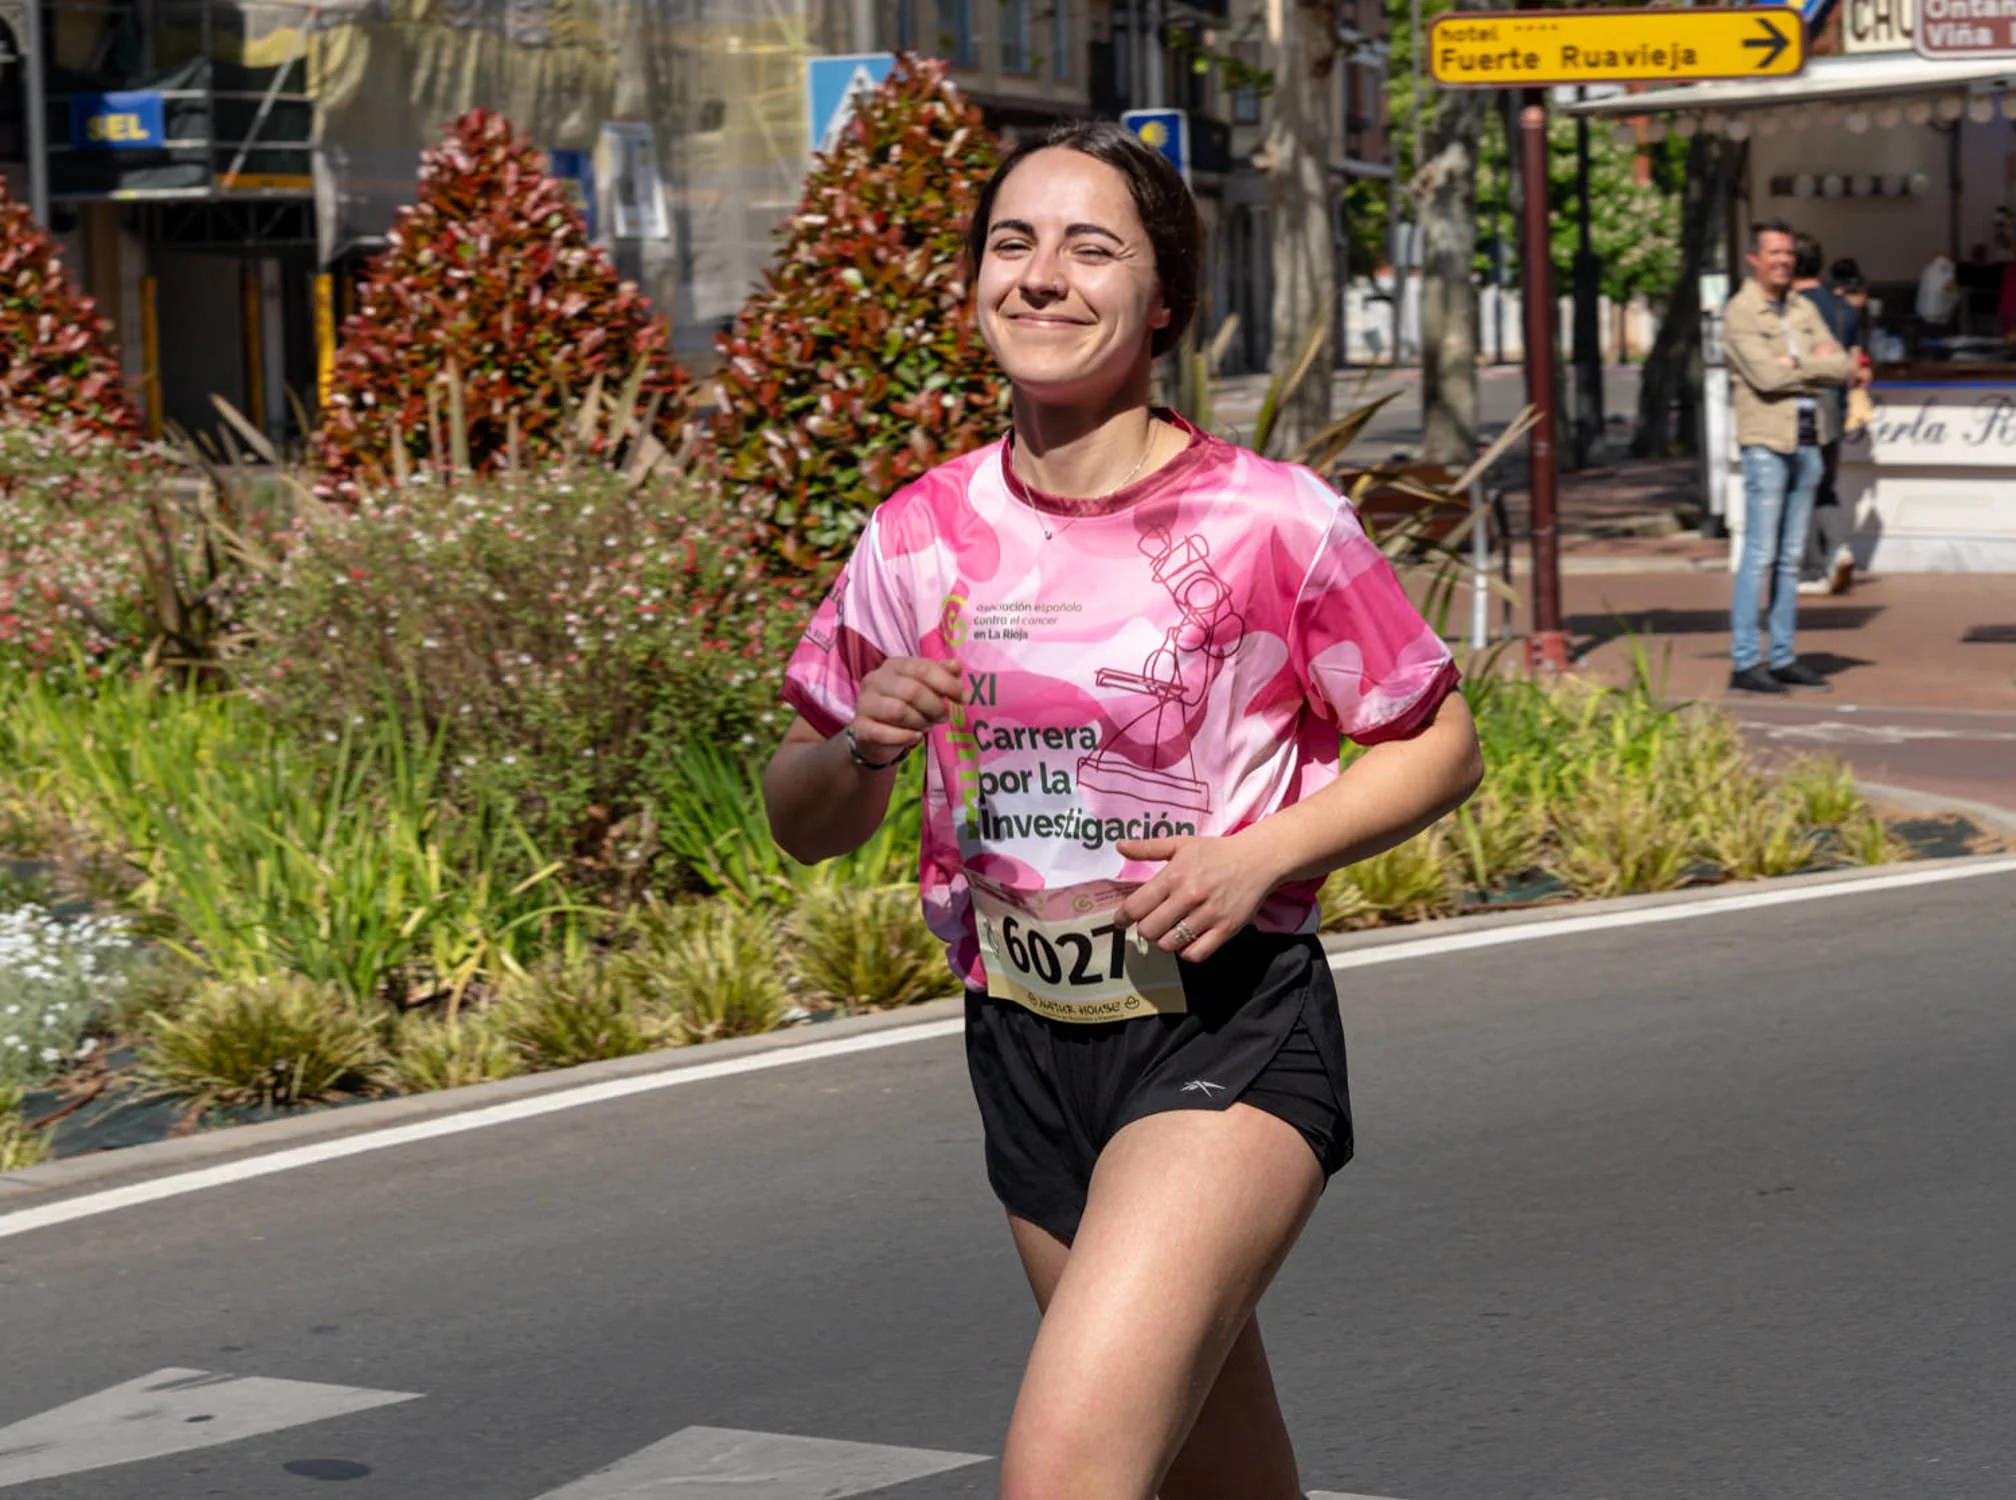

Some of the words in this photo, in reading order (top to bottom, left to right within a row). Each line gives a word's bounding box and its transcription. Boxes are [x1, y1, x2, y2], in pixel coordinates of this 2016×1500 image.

[1440, 26, 1498, 43] hotel
[1926, 22, 1993, 47] Viña
[1441, 47, 1540, 71] Fuerte
[1560, 42, 1698, 71] Ruavieja
[974, 616, 1008, 626] contra
[1009, 616, 1020, 625] el
[974, 631, 986, 640] en
[988, 629, 1001, 640] La
[1003, 629, 1029, 641] Rioja
[967, 673, 996, 707] XI
[973, 719, 1099, 752] Carrera
[946, 699, 980, 840] muje
[978, 769, 1032, 804] por
[1038, 762, 1072, 795] la
[980, 808, 1196, 850] Investigación
[1002, 915, 1127, 986] 6027
